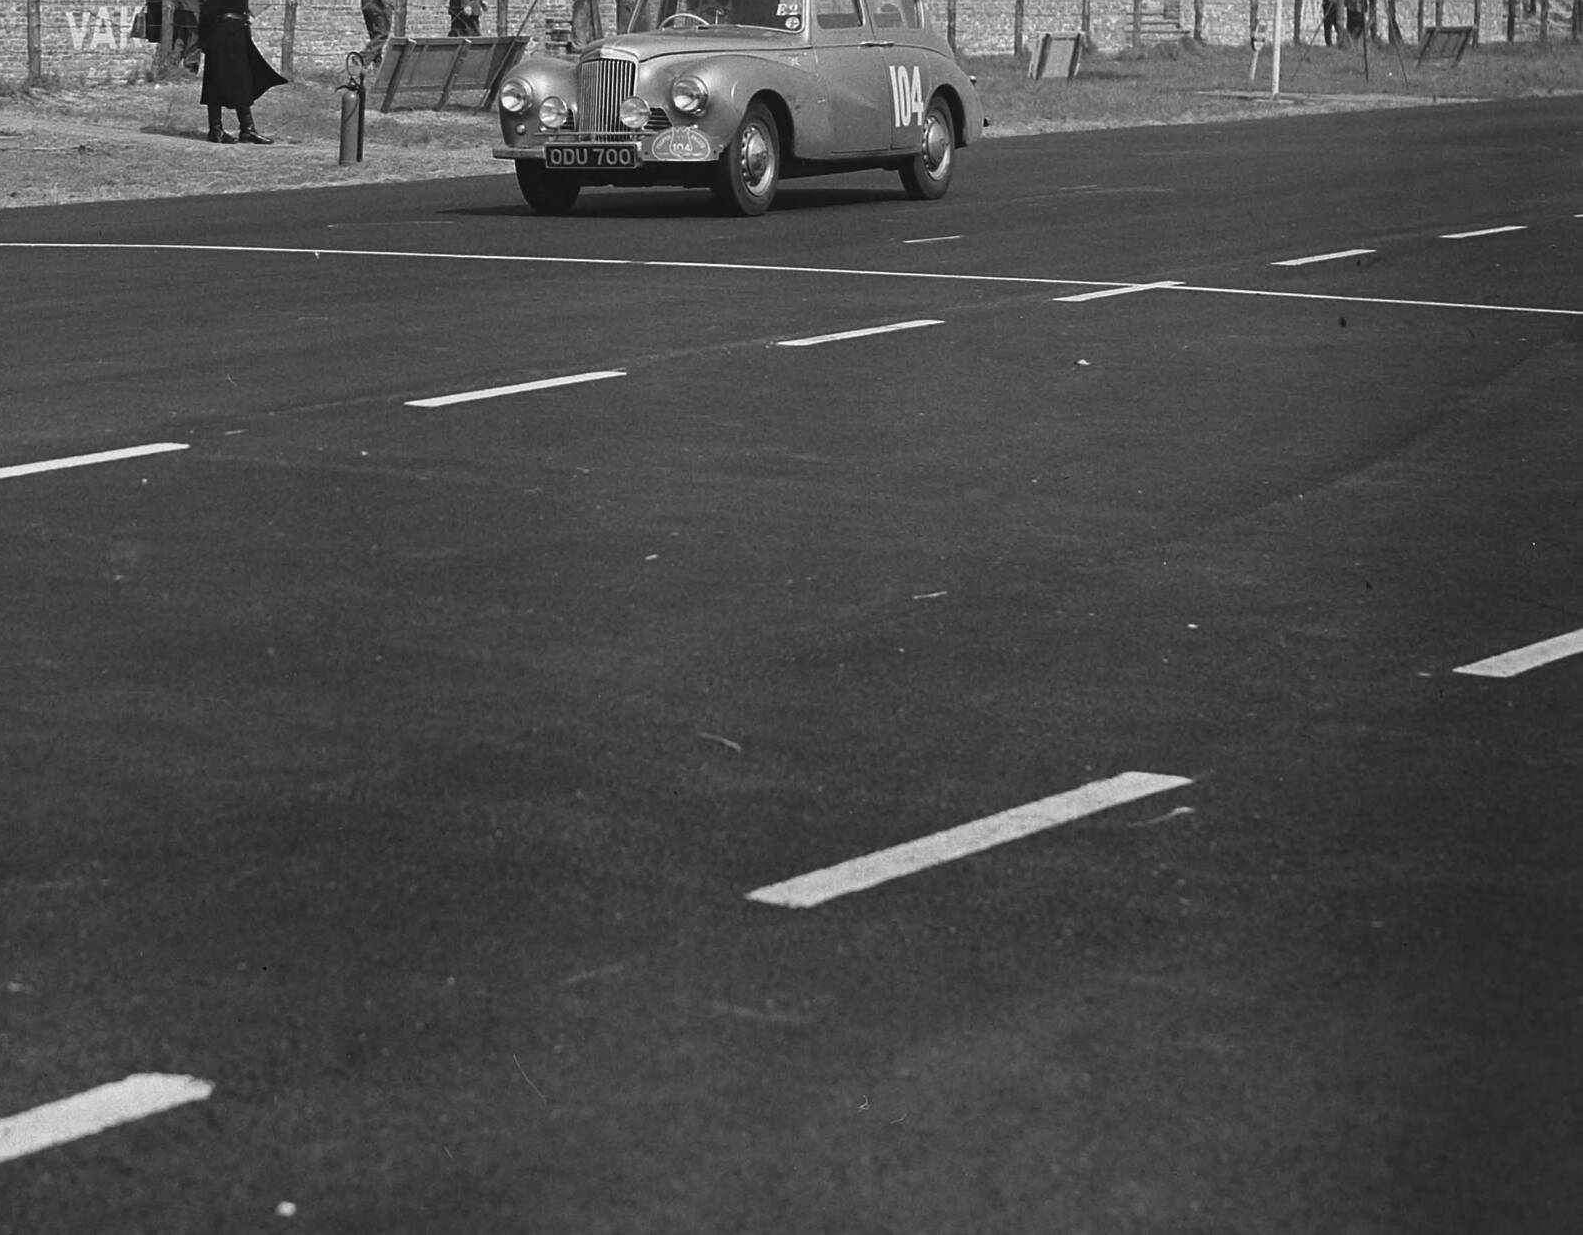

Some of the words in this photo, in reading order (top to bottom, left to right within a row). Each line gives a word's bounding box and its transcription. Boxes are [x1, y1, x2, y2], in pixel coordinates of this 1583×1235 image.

[889, 65, 924, 127] 104
[550, 148, 589, 165] ODU
[593, 148, 631, 165] 700
